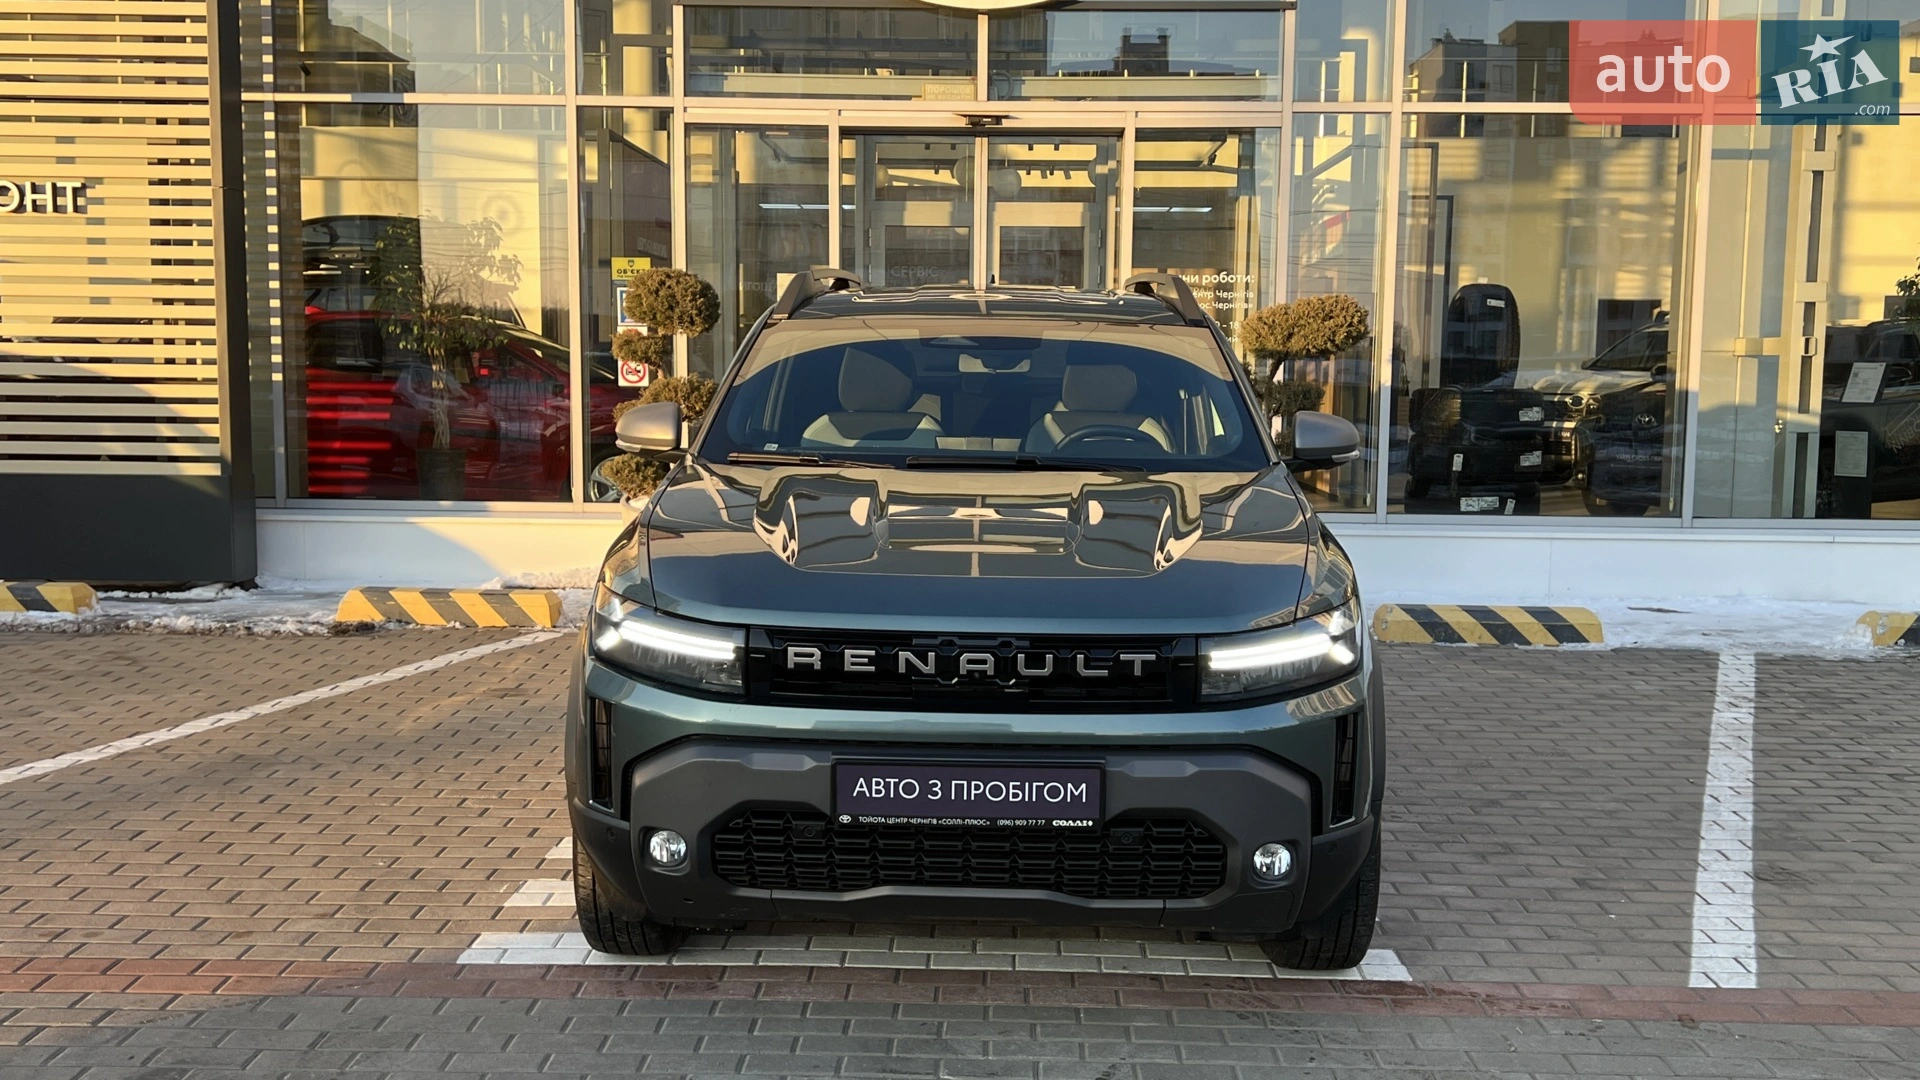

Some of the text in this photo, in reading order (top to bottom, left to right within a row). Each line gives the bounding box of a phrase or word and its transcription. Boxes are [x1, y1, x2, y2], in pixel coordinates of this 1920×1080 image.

[891, 265, 938, 277] СЕРВІС
[1179, 271, 1255, 286] ни роботи:
[1216, 289, 1254, 300] Чернігів
[787, 646, 1156, 677] RENAULT
[852, 777, 1087, 803] АВТО З ПРОБІГОМ
[858, 815, 886, 823] ТОЙОТА
[909, 817, 937, 825] ЧЕРНІГІВ
[997, 819, 1014, 827] (096)
